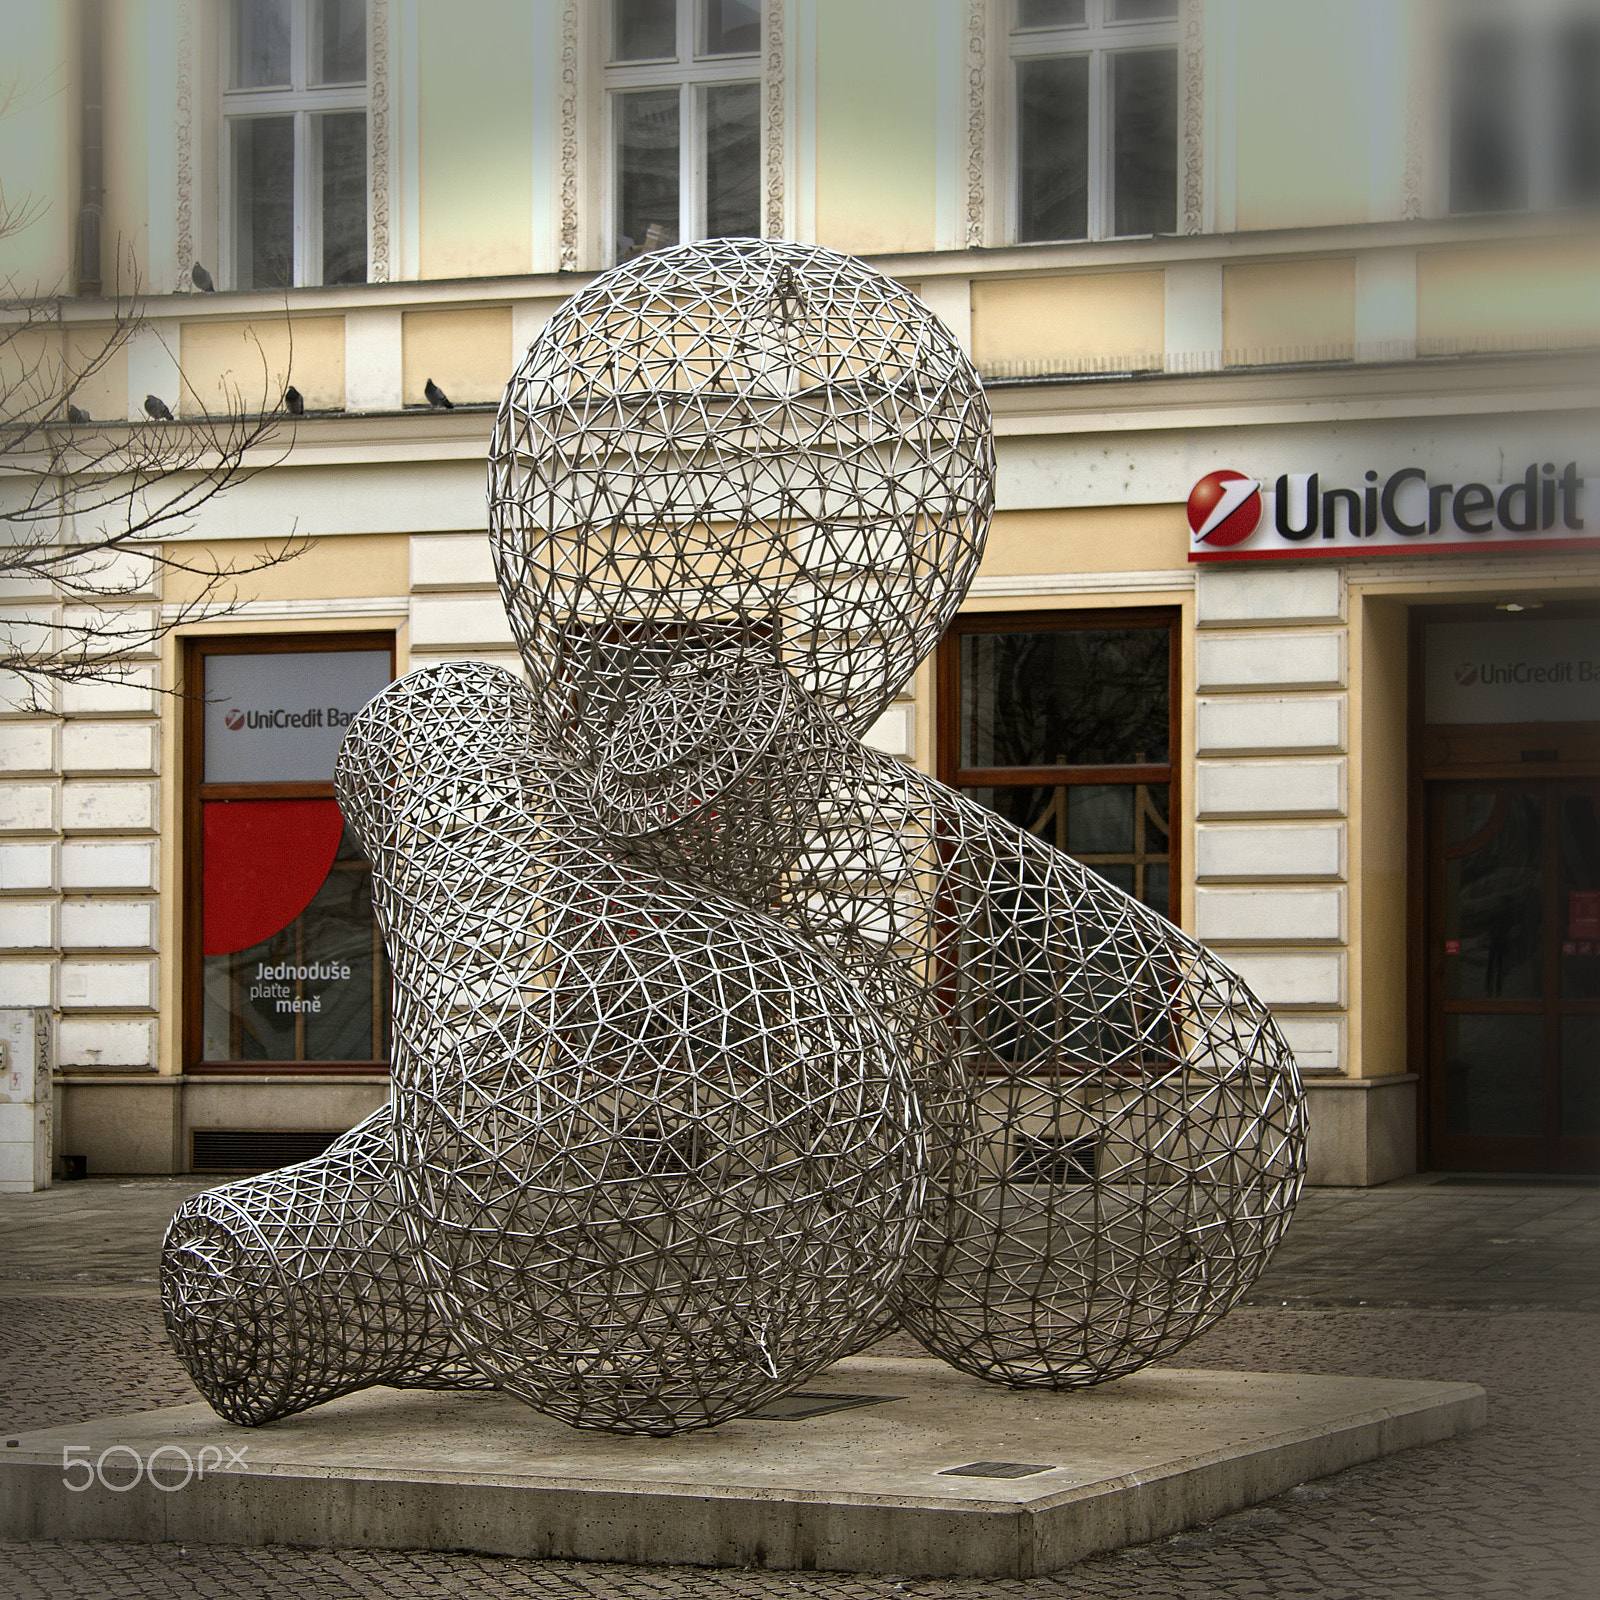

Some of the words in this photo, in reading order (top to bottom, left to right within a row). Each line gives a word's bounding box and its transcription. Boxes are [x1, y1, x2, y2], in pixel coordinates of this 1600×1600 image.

[1275, 461, 1584, 541] UniCredit
[1480, 661, 1573, 684] UniCredit
[246, 708, 323, 730] UniCredit
[255, 961, 351, 980] Jednoduše
[276, 995, 321, 1013] méně
